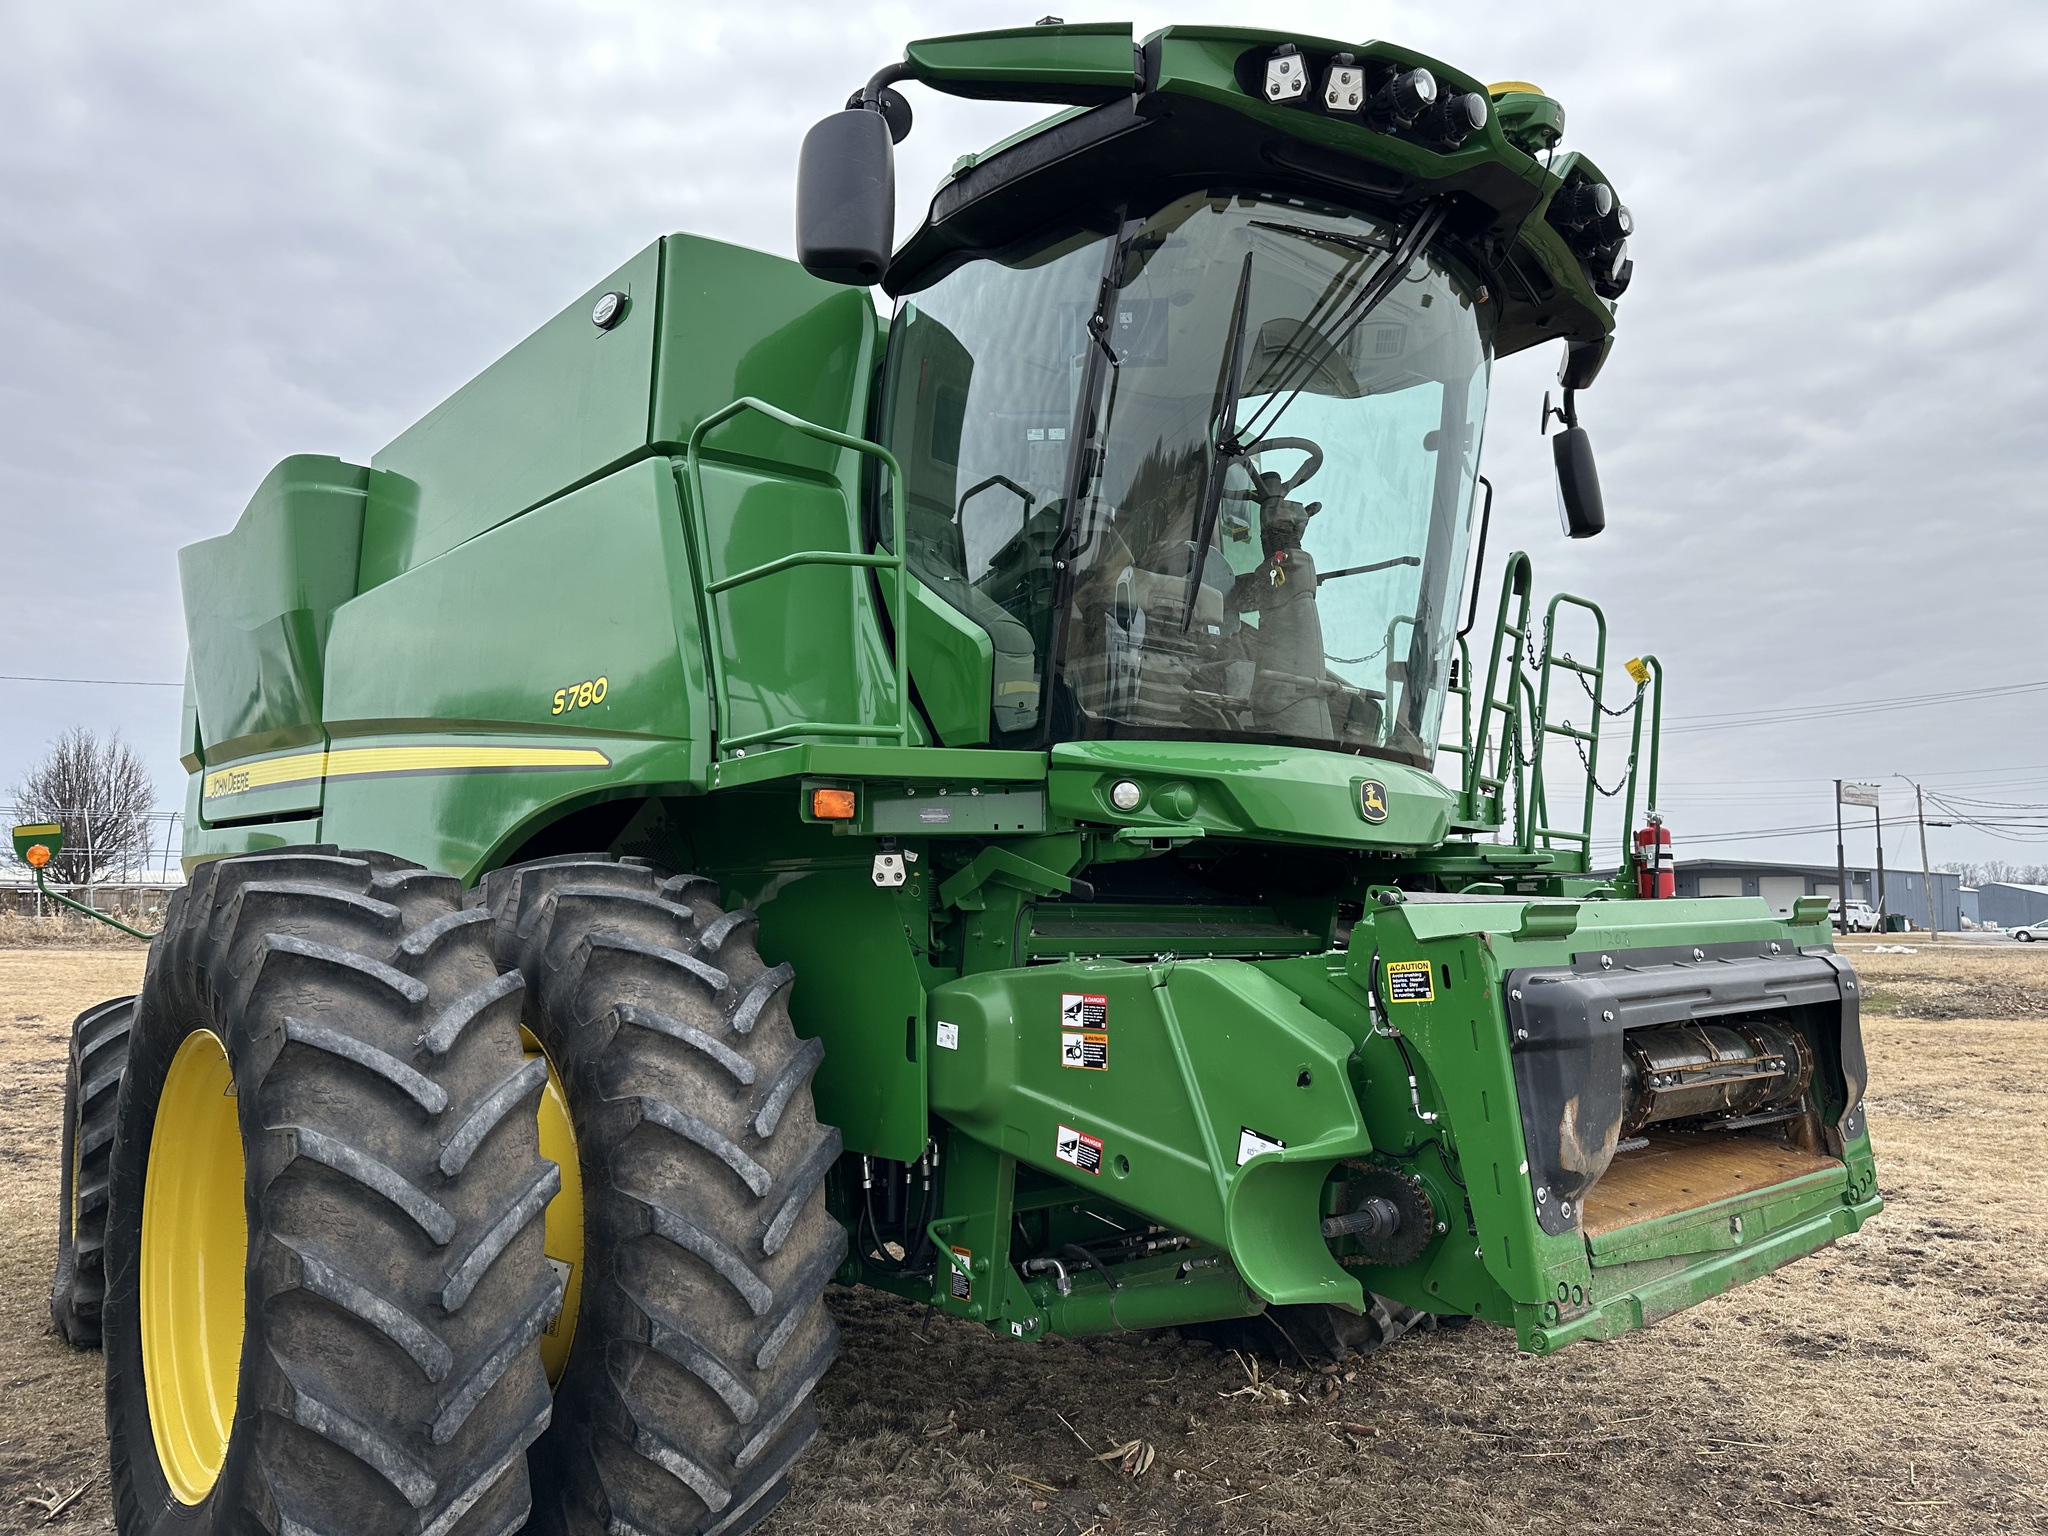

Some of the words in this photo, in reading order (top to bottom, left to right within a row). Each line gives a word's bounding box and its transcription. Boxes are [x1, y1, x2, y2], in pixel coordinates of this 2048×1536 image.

[551, 675, 609, 716] S780
[212, 777, 228, 796] JOHN
[228, 772, 250, 791] DEERE
[1084, 1136, 1101, 1148] DANGER
